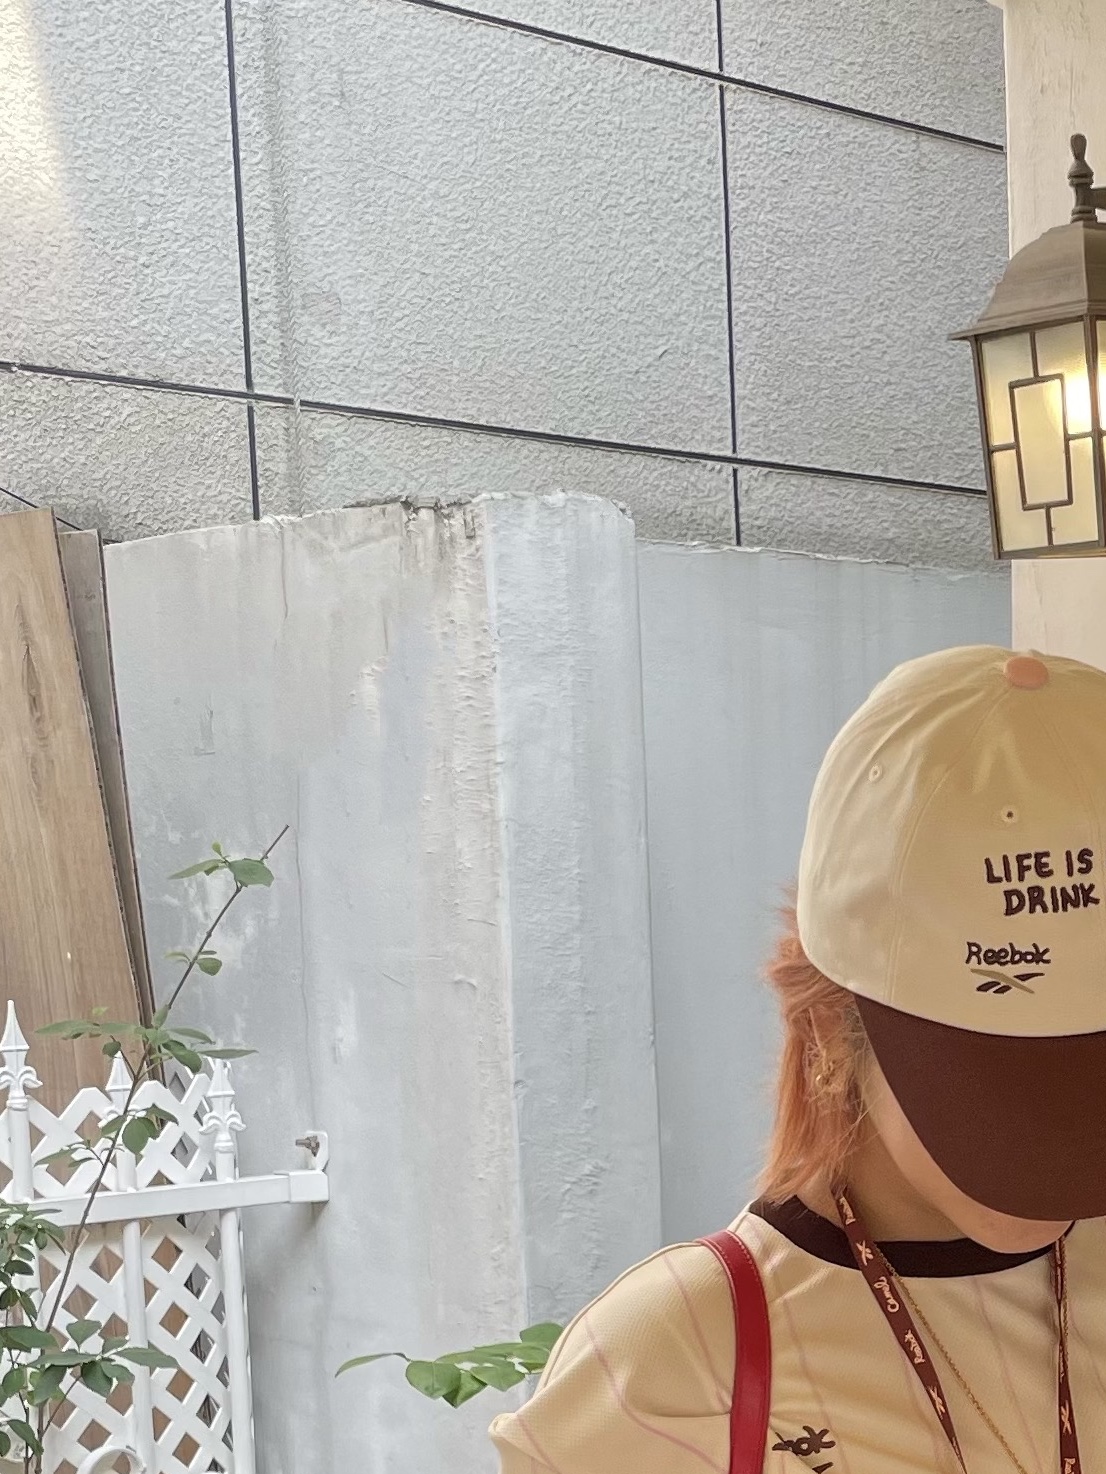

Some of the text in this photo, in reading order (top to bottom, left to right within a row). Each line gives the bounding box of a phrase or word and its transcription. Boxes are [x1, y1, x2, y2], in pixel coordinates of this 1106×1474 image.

[985, 850, 1054, 884] LIFE
[1065, 848, 1094, 877] IS
[1003, 883, 1100, 916] DRINK
[965, 942, 1051, 966] Reebok
[874, 1276, 900, 1313] Camel
